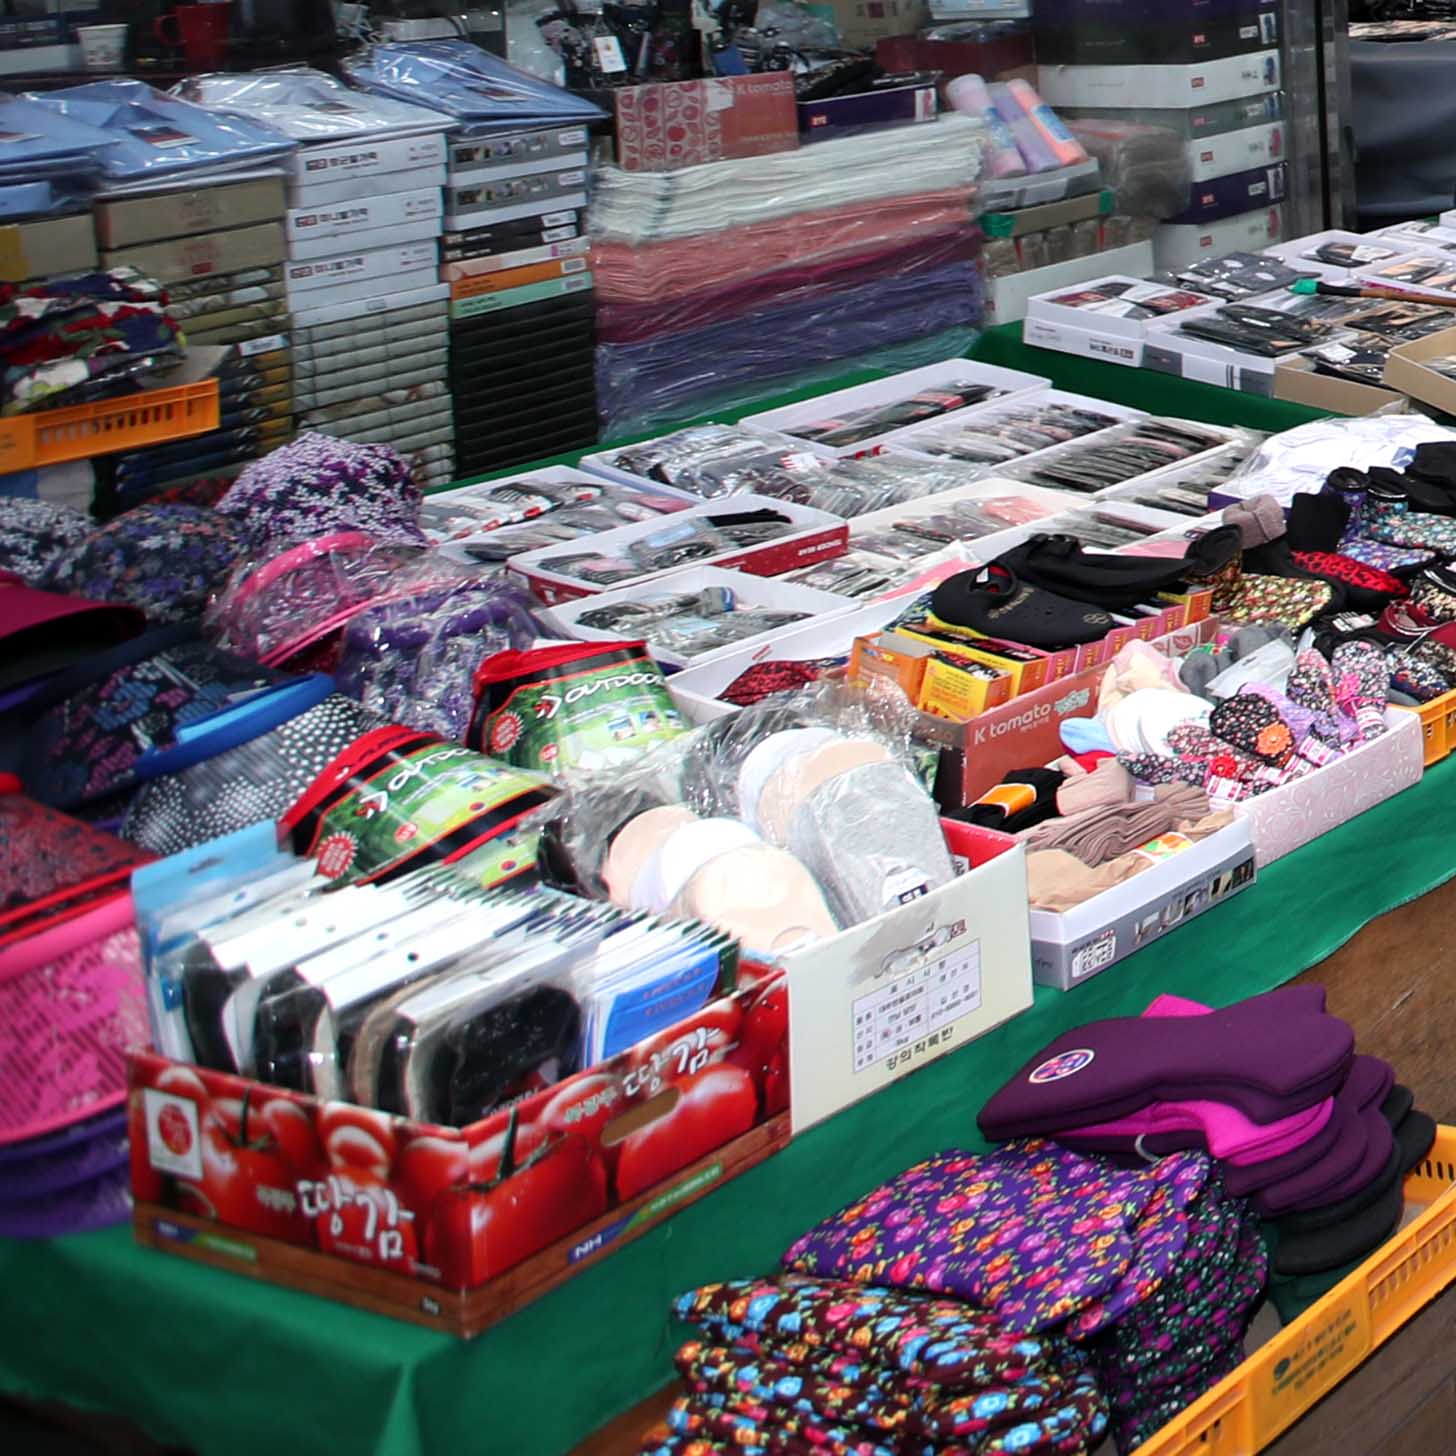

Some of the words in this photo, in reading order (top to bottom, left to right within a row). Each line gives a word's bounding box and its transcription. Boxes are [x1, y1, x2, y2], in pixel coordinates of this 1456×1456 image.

[974, 726, 986, 745] K
[990, 702, 1052, 737] tomato
[388, 747, 481, 791] OUTDO
[575, 1233, 603, 1259] NH
